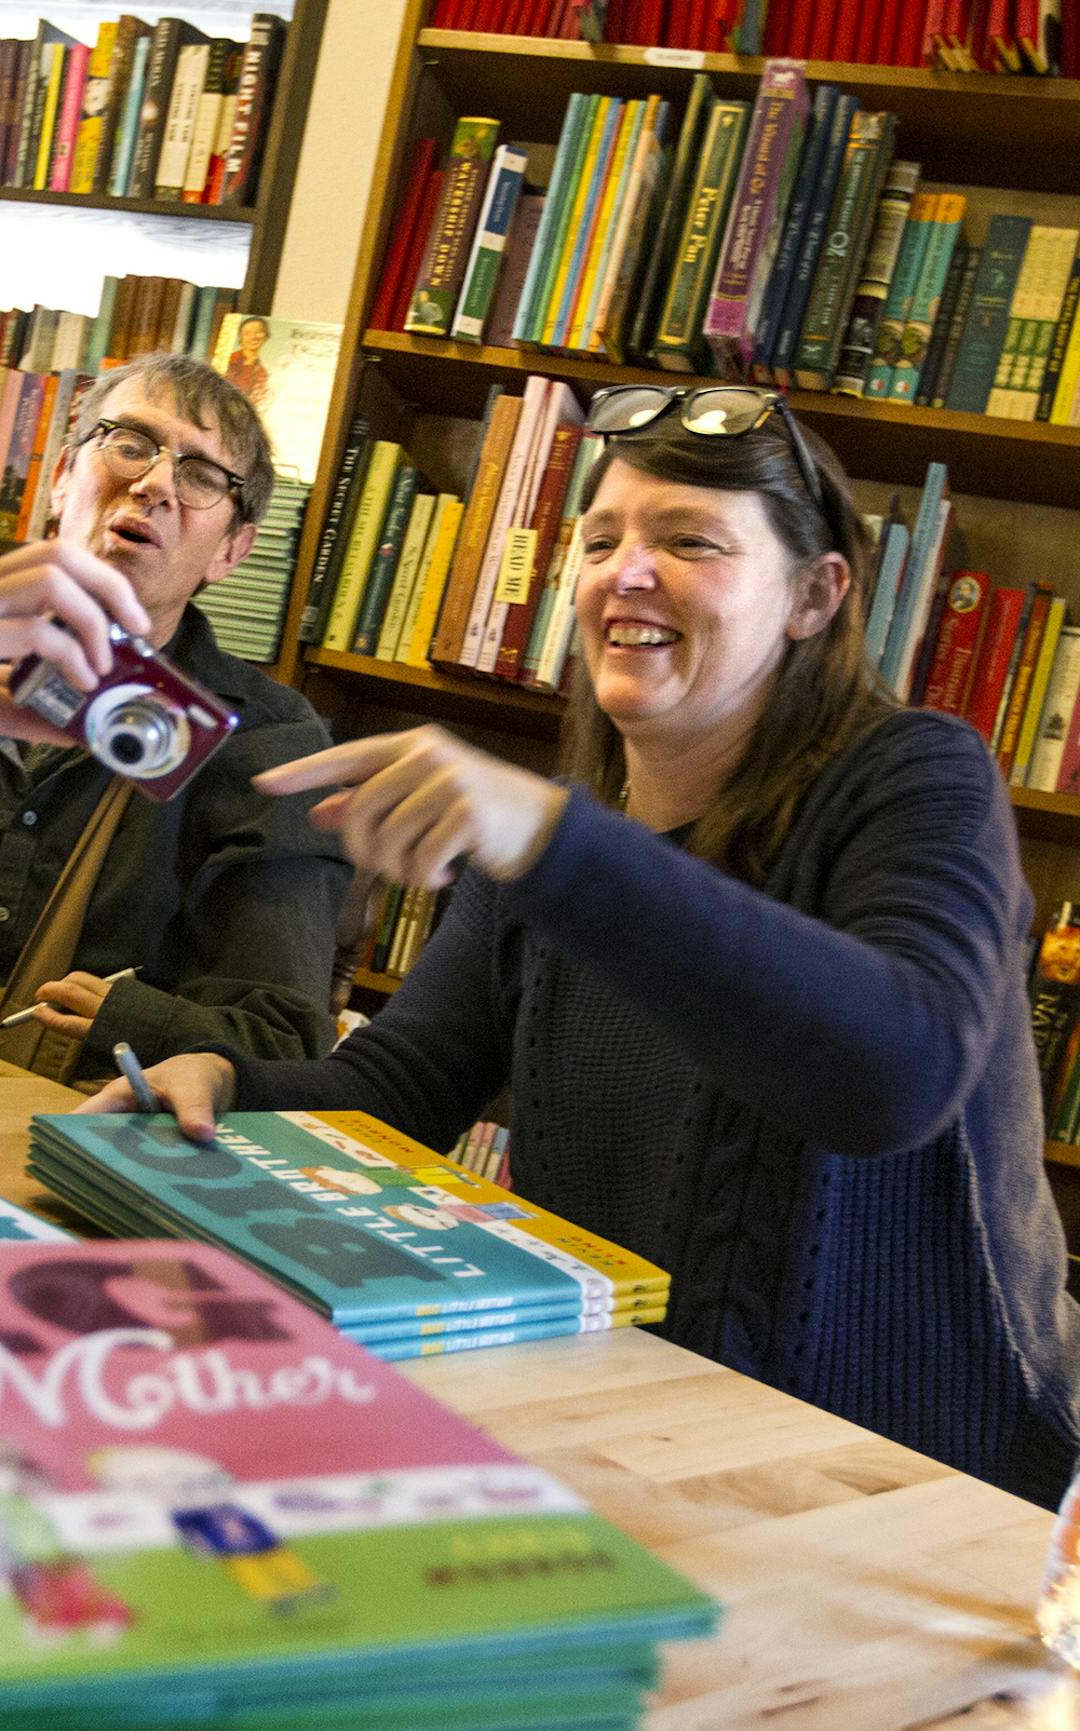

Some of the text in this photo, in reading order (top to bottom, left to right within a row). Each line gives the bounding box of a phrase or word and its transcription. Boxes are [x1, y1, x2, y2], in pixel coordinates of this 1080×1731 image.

[238, 52, 263, 116] NIGHT
[226, 121, 249, 173] FILM
[443, 162, 472, 237] WATERSHIP
[682, 187, 718, 264] Peter Pan
[430, 244, 451, 286] DOWN
[313, 448, 359, 582] THE SECRET GARDEN
[504, 535, 529, 597] READ ME
[91, 1123, 446, 1289] BIG
[336, 1206, 487, 1279] LITTLE
